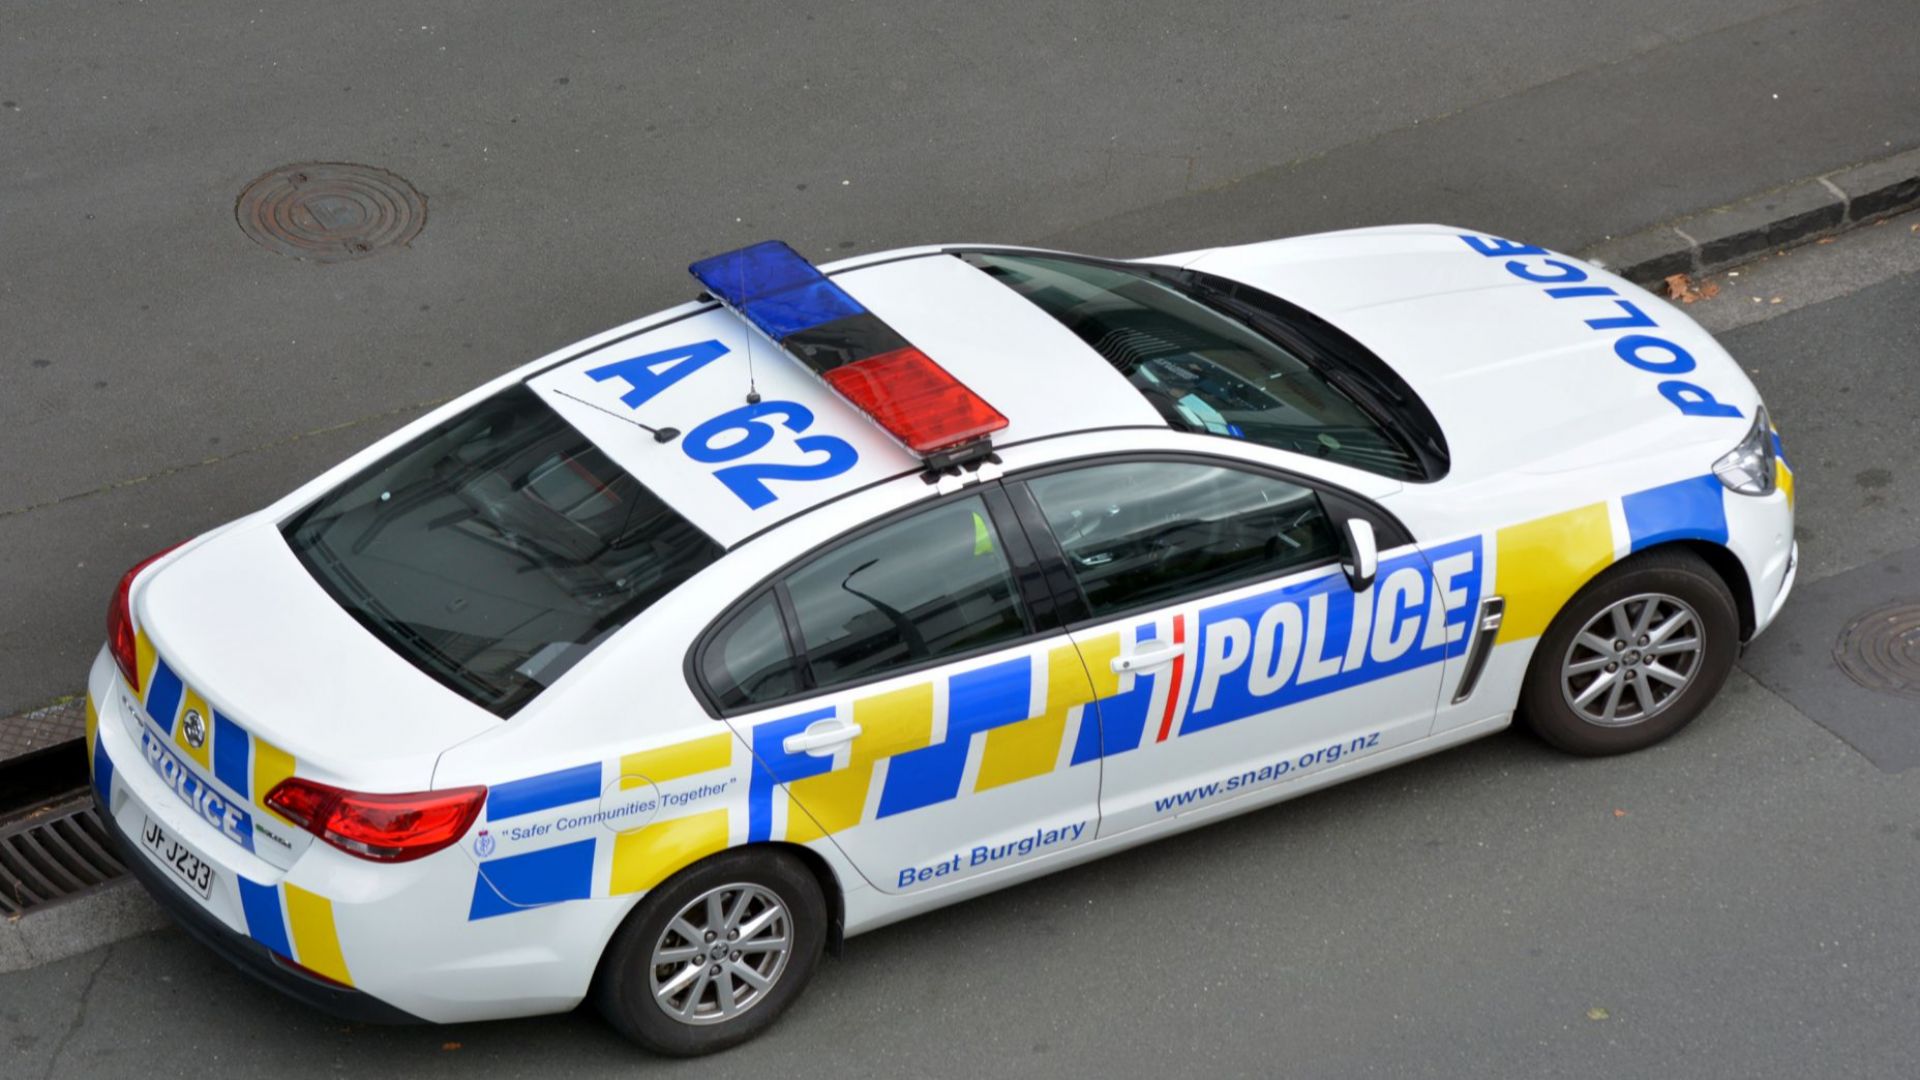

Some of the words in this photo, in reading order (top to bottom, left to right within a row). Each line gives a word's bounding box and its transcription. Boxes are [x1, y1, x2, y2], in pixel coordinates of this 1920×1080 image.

[1457, 235, 1746, 419] POLICE
[583, 338, 732, 410] A
[681, 400, 859, 511] 62
[1192, 550, 1475, 714] POLICE
[146, 736, 244, 845] POLICE
[556, 798, 656, 832] Communities
[1154, 730, 1381, 813] www.snap.org.nz
[146, 823, 211, 891] JFJ233
[897, 854, 961, 888] Beat
[969, 820, 1087, 868] Burglary
